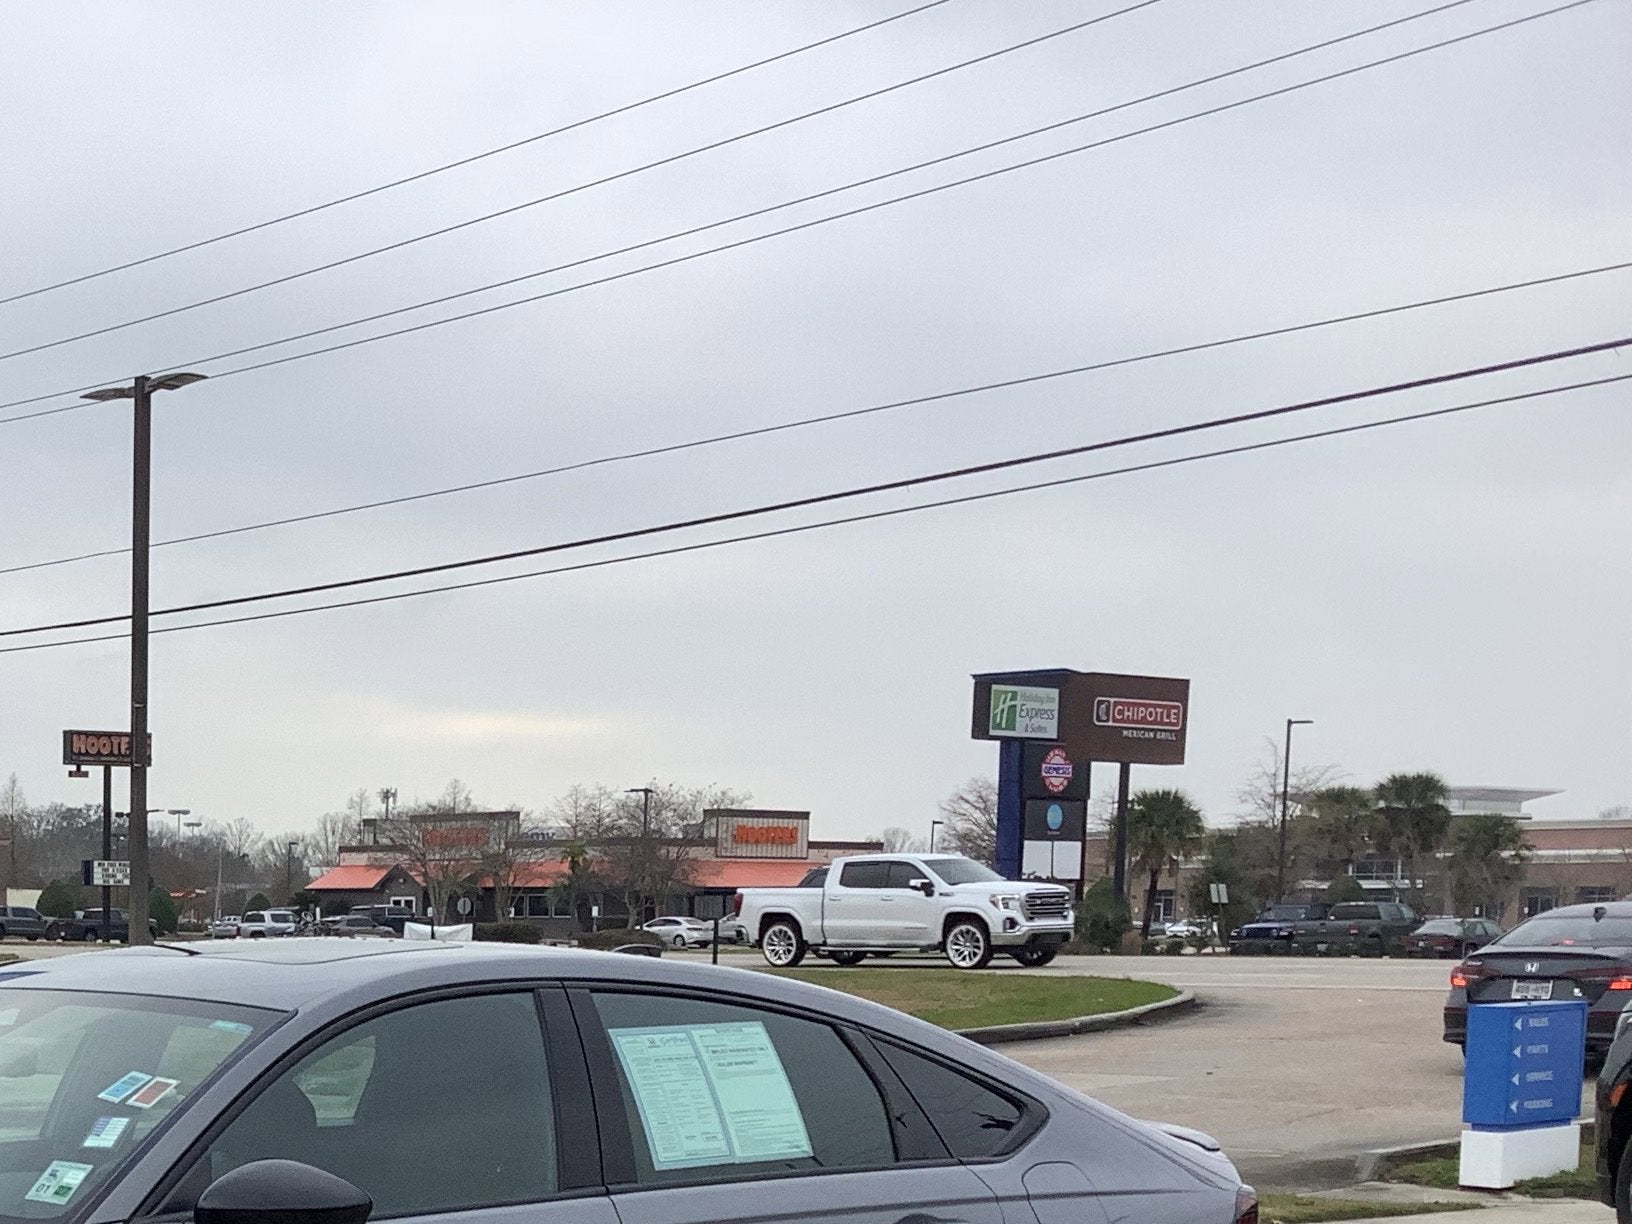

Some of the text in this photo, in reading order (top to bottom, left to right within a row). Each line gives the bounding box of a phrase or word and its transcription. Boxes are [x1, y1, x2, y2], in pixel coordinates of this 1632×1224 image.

[1019, 703, 1055, 721] Express
[1114, 705, 1178, 723] CHIPOTLE
[1122, 729, 1177, 741] MEXICAN GRILL
